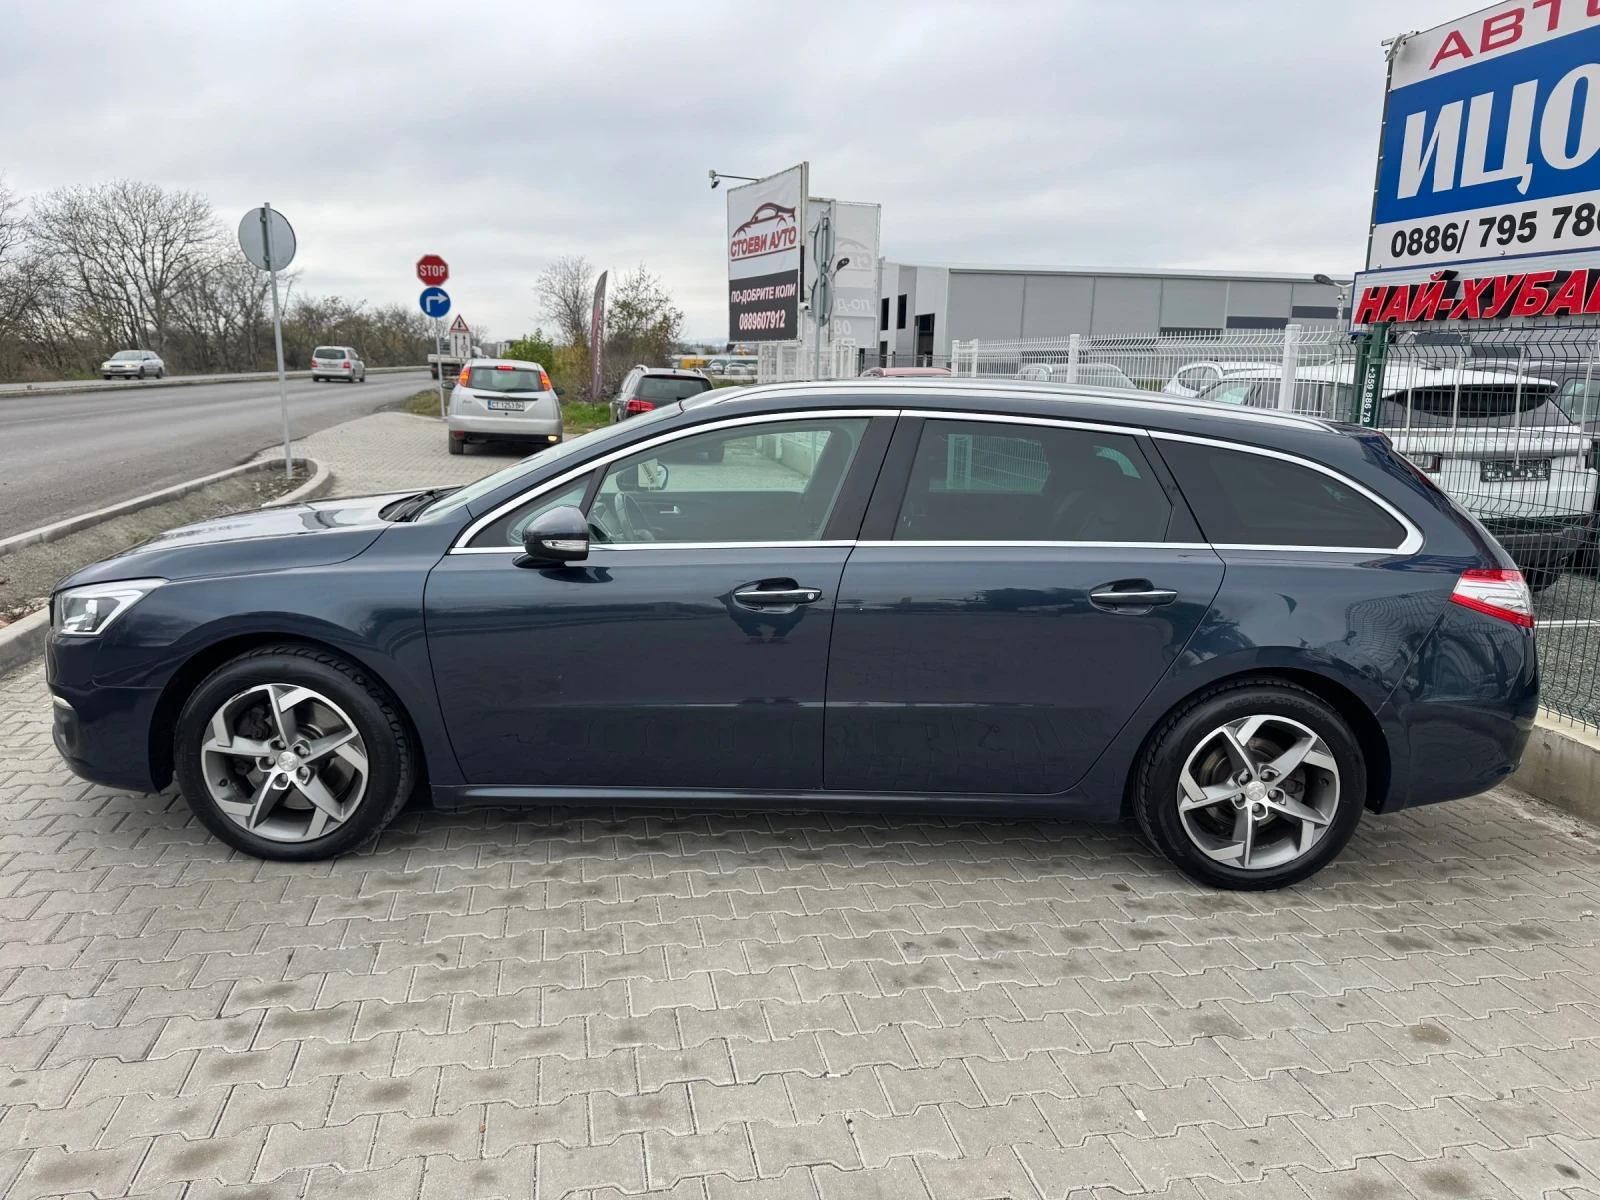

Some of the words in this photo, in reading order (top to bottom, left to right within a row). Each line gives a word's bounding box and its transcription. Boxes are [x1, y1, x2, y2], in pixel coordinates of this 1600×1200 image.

[1429, 0, 1600, 70] АВТ
[1391, 220, 1469, 257] 0886/
[1479, 210, 1538, 248] 795
[1552, 202, 1600, 239] 78
[731, 233, 767, 257] СТОЕВИ
[768, 226, 797, 250] АУТО
[420, 265, 446, 276] STOP
[731, 286, 775, 305] ПО-ДОБРИТЕ
[775, 283, 796, 298] КОЛИ
[739, 309, 786, 330] 0889607912
[1366, 366, 1376, 390] +359
[1364, 392, 1373, 409] 886
